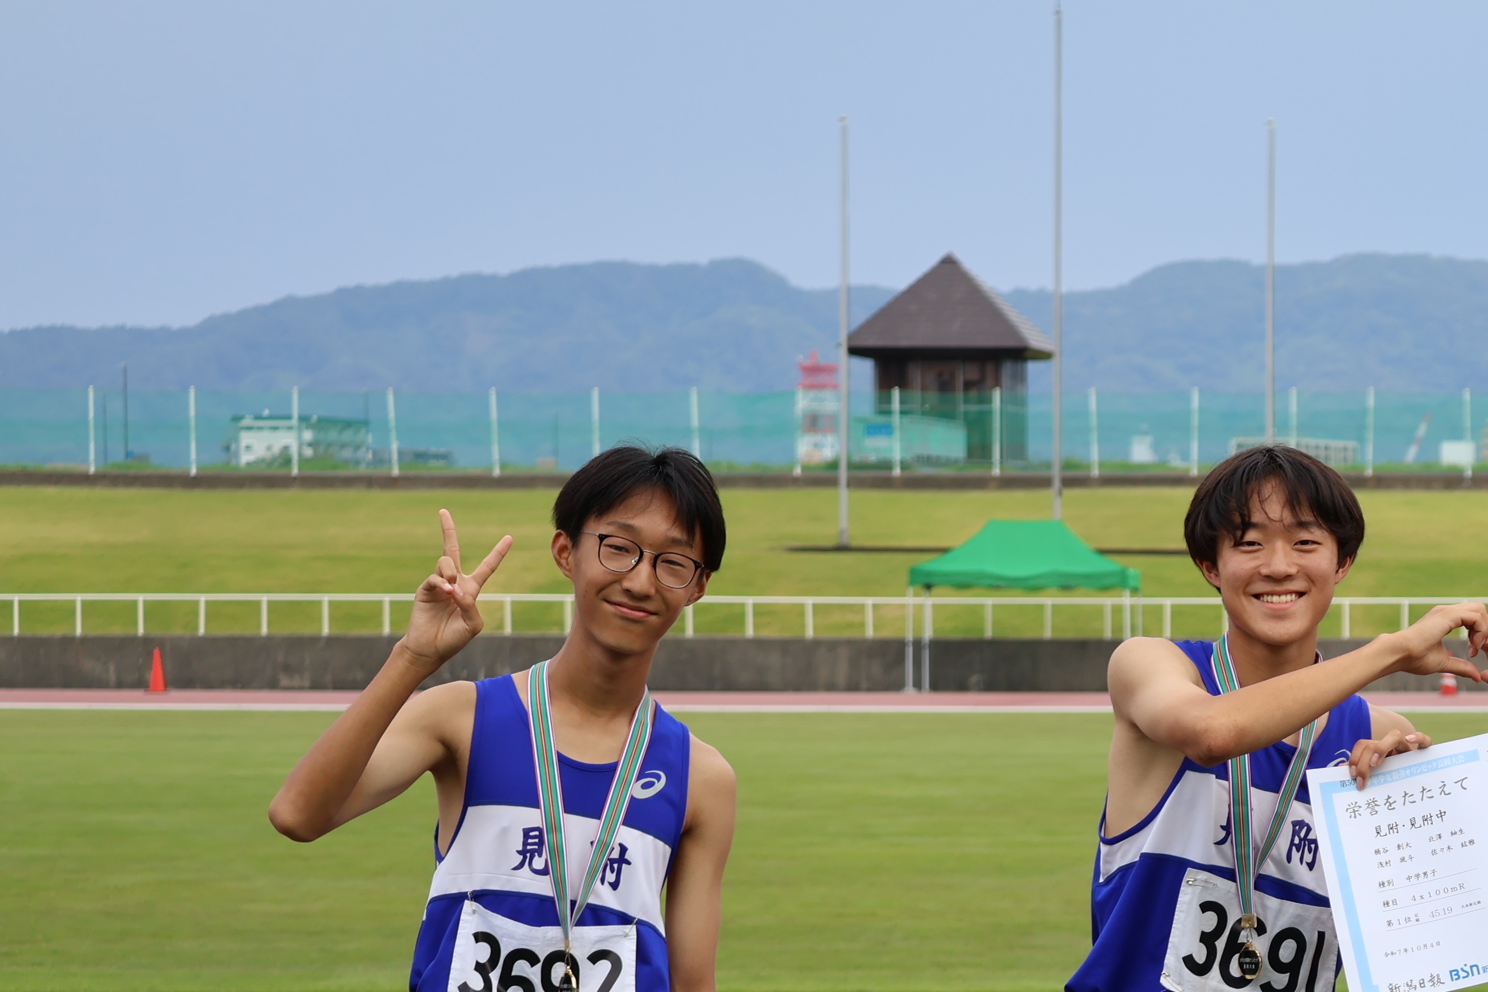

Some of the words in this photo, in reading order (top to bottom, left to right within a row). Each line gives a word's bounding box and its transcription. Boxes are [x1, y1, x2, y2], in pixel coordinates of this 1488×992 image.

[1345, 776, 1469, 819] 栄誉をたたえて
[1374, 809, 1447, 838] 見附・見附中
[1430, 844, 1454, 856] 佐々木
[1378, 878, 1395, 889] 種別
[1405, 868, 1438, 883] 中学男子
[1382, 898, 1398, 909] 種目
[1429, 906, 1453, 919] 45.19
